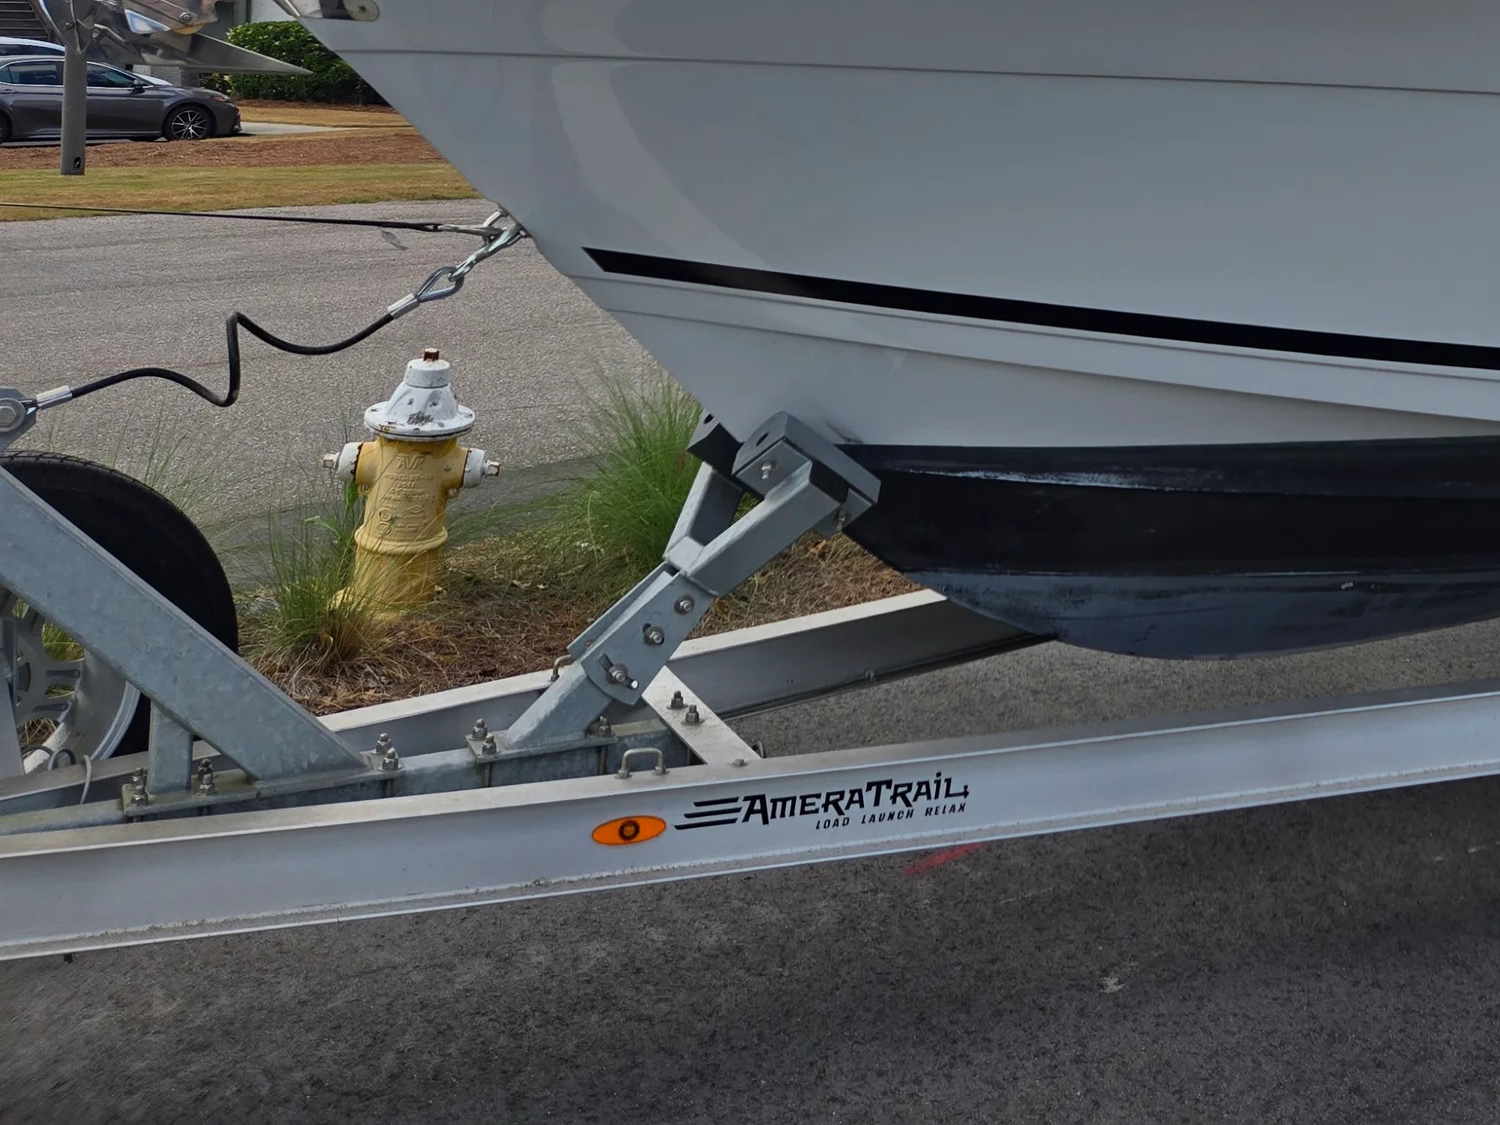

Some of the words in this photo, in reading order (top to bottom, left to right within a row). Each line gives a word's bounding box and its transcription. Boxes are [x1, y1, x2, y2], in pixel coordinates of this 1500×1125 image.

[815, 817, 850, 830] LOAD
[861, 809, 914, 824] LAUNCH
[925, 802, 967, 816] RELAX
